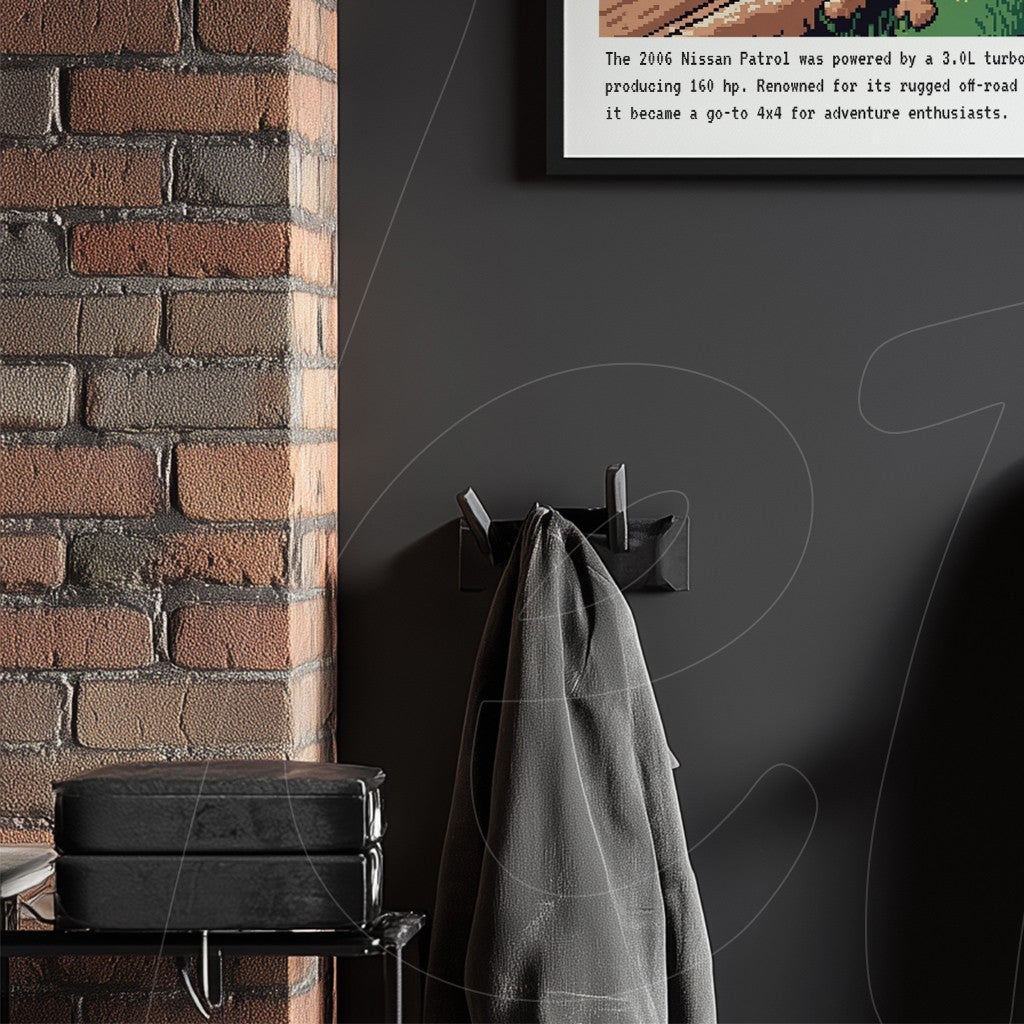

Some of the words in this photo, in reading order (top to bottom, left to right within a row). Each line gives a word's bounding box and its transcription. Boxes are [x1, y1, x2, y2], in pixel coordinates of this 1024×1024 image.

[605, 51, 631, 66] The
[639, 51, 673, 66] 2006
[681, 51, 732, 66] Nissan
[739, 50, 790, 66] Patrol
[798, 54, 824, 66] was
[832, 50, 892, 69] powered
[899, 50, 917, 69] by
[924, 54, 934, 66] a
[942, 50, 976, 66] 3.0L
[605, 78, 682, 97] producing
[690, 78, 715, 93] 160
[722, 78, 747, 97] hp.
[756, 78, 825, 93] Renowned
[833, 78, 858, 93] for
[866, 78, 891, 93] its
[899, 78, 951, 97] rugged
[958, 78, 1018, 93] off-road
[605, 106, 622, 120] it
[630, 106, 682, 120] became
[689, 109, 698, 120] a
[706, 106, 749, 124] go-to
[756, 105, 783, 120] 4x4
[791, 105, 816, 120] for
[824, 105, 901, 120] adventure
[907, 105, 1007, 120] enthusiasts.
